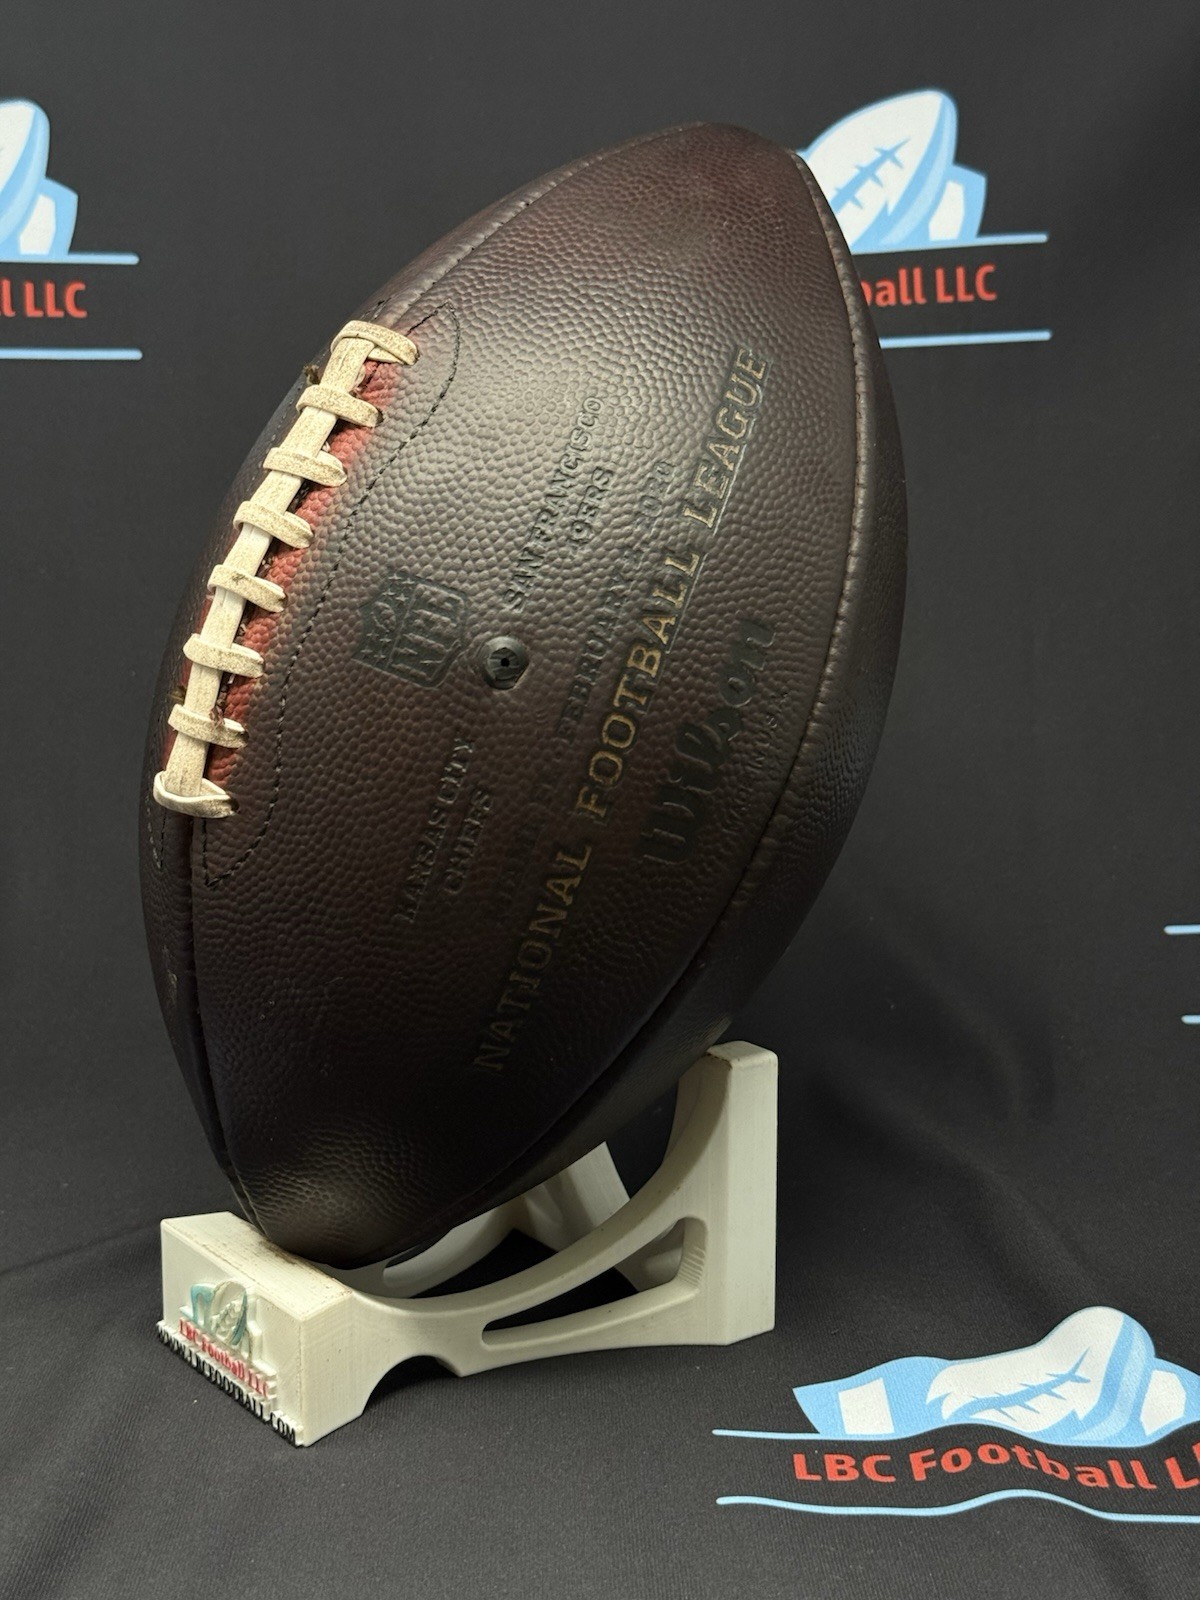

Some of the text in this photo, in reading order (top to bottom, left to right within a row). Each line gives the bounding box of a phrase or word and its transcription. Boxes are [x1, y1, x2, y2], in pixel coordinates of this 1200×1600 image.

[25, 280, 87, 318] LLC
[935, 262, 997, 303] LLC
[504, 396, 602, 614] SAN FRANCISCO
[474, 348, 767, 1077] NATIONAL FOOTBALL LEAGUE
[793, 1452, 897, 1483] LBC
[908, 1442, 1157, 1490] Football
